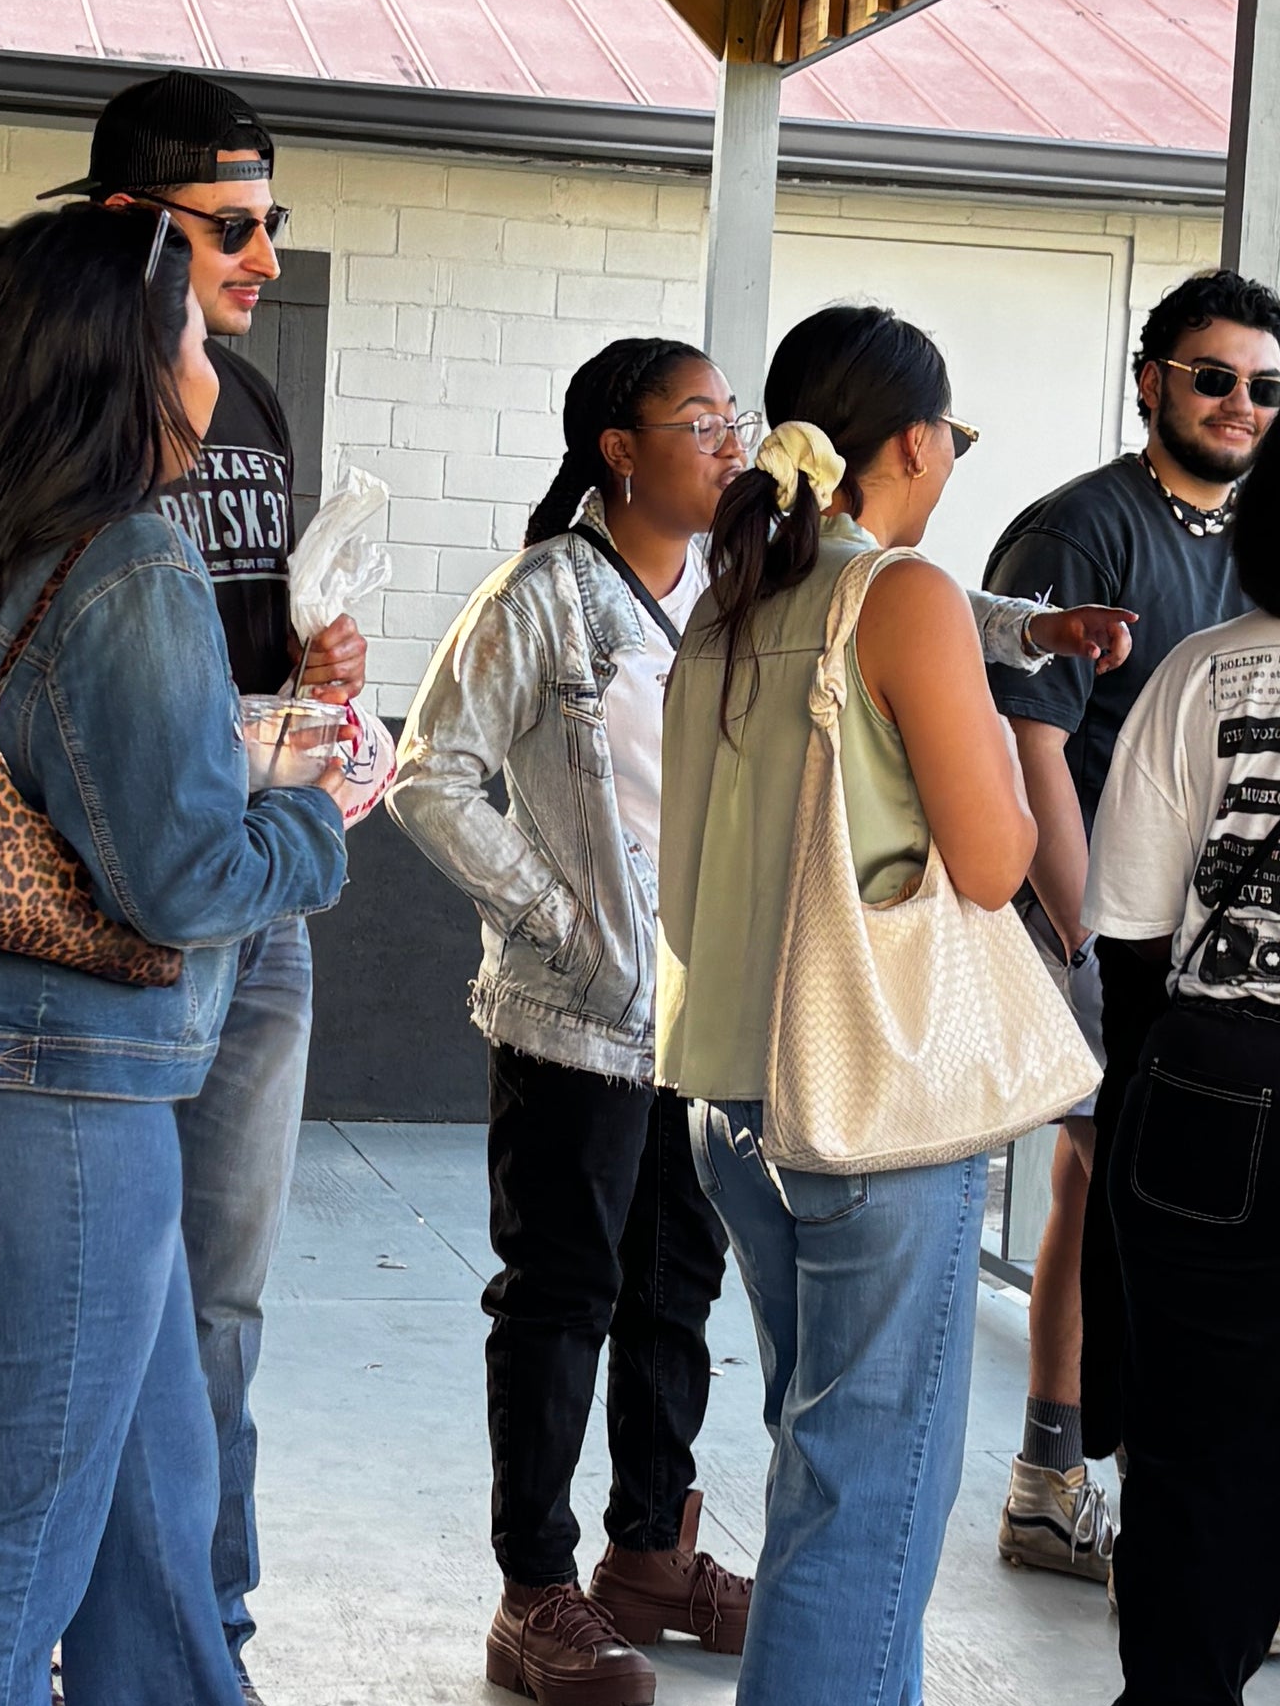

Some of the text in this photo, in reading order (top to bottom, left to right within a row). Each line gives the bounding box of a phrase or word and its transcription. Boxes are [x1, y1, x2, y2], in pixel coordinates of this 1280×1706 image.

[233, 558, 256, 570] STAR
[1220, 654, 1272, 672] ROLLING
[1246, 685, 1264, 695] the
